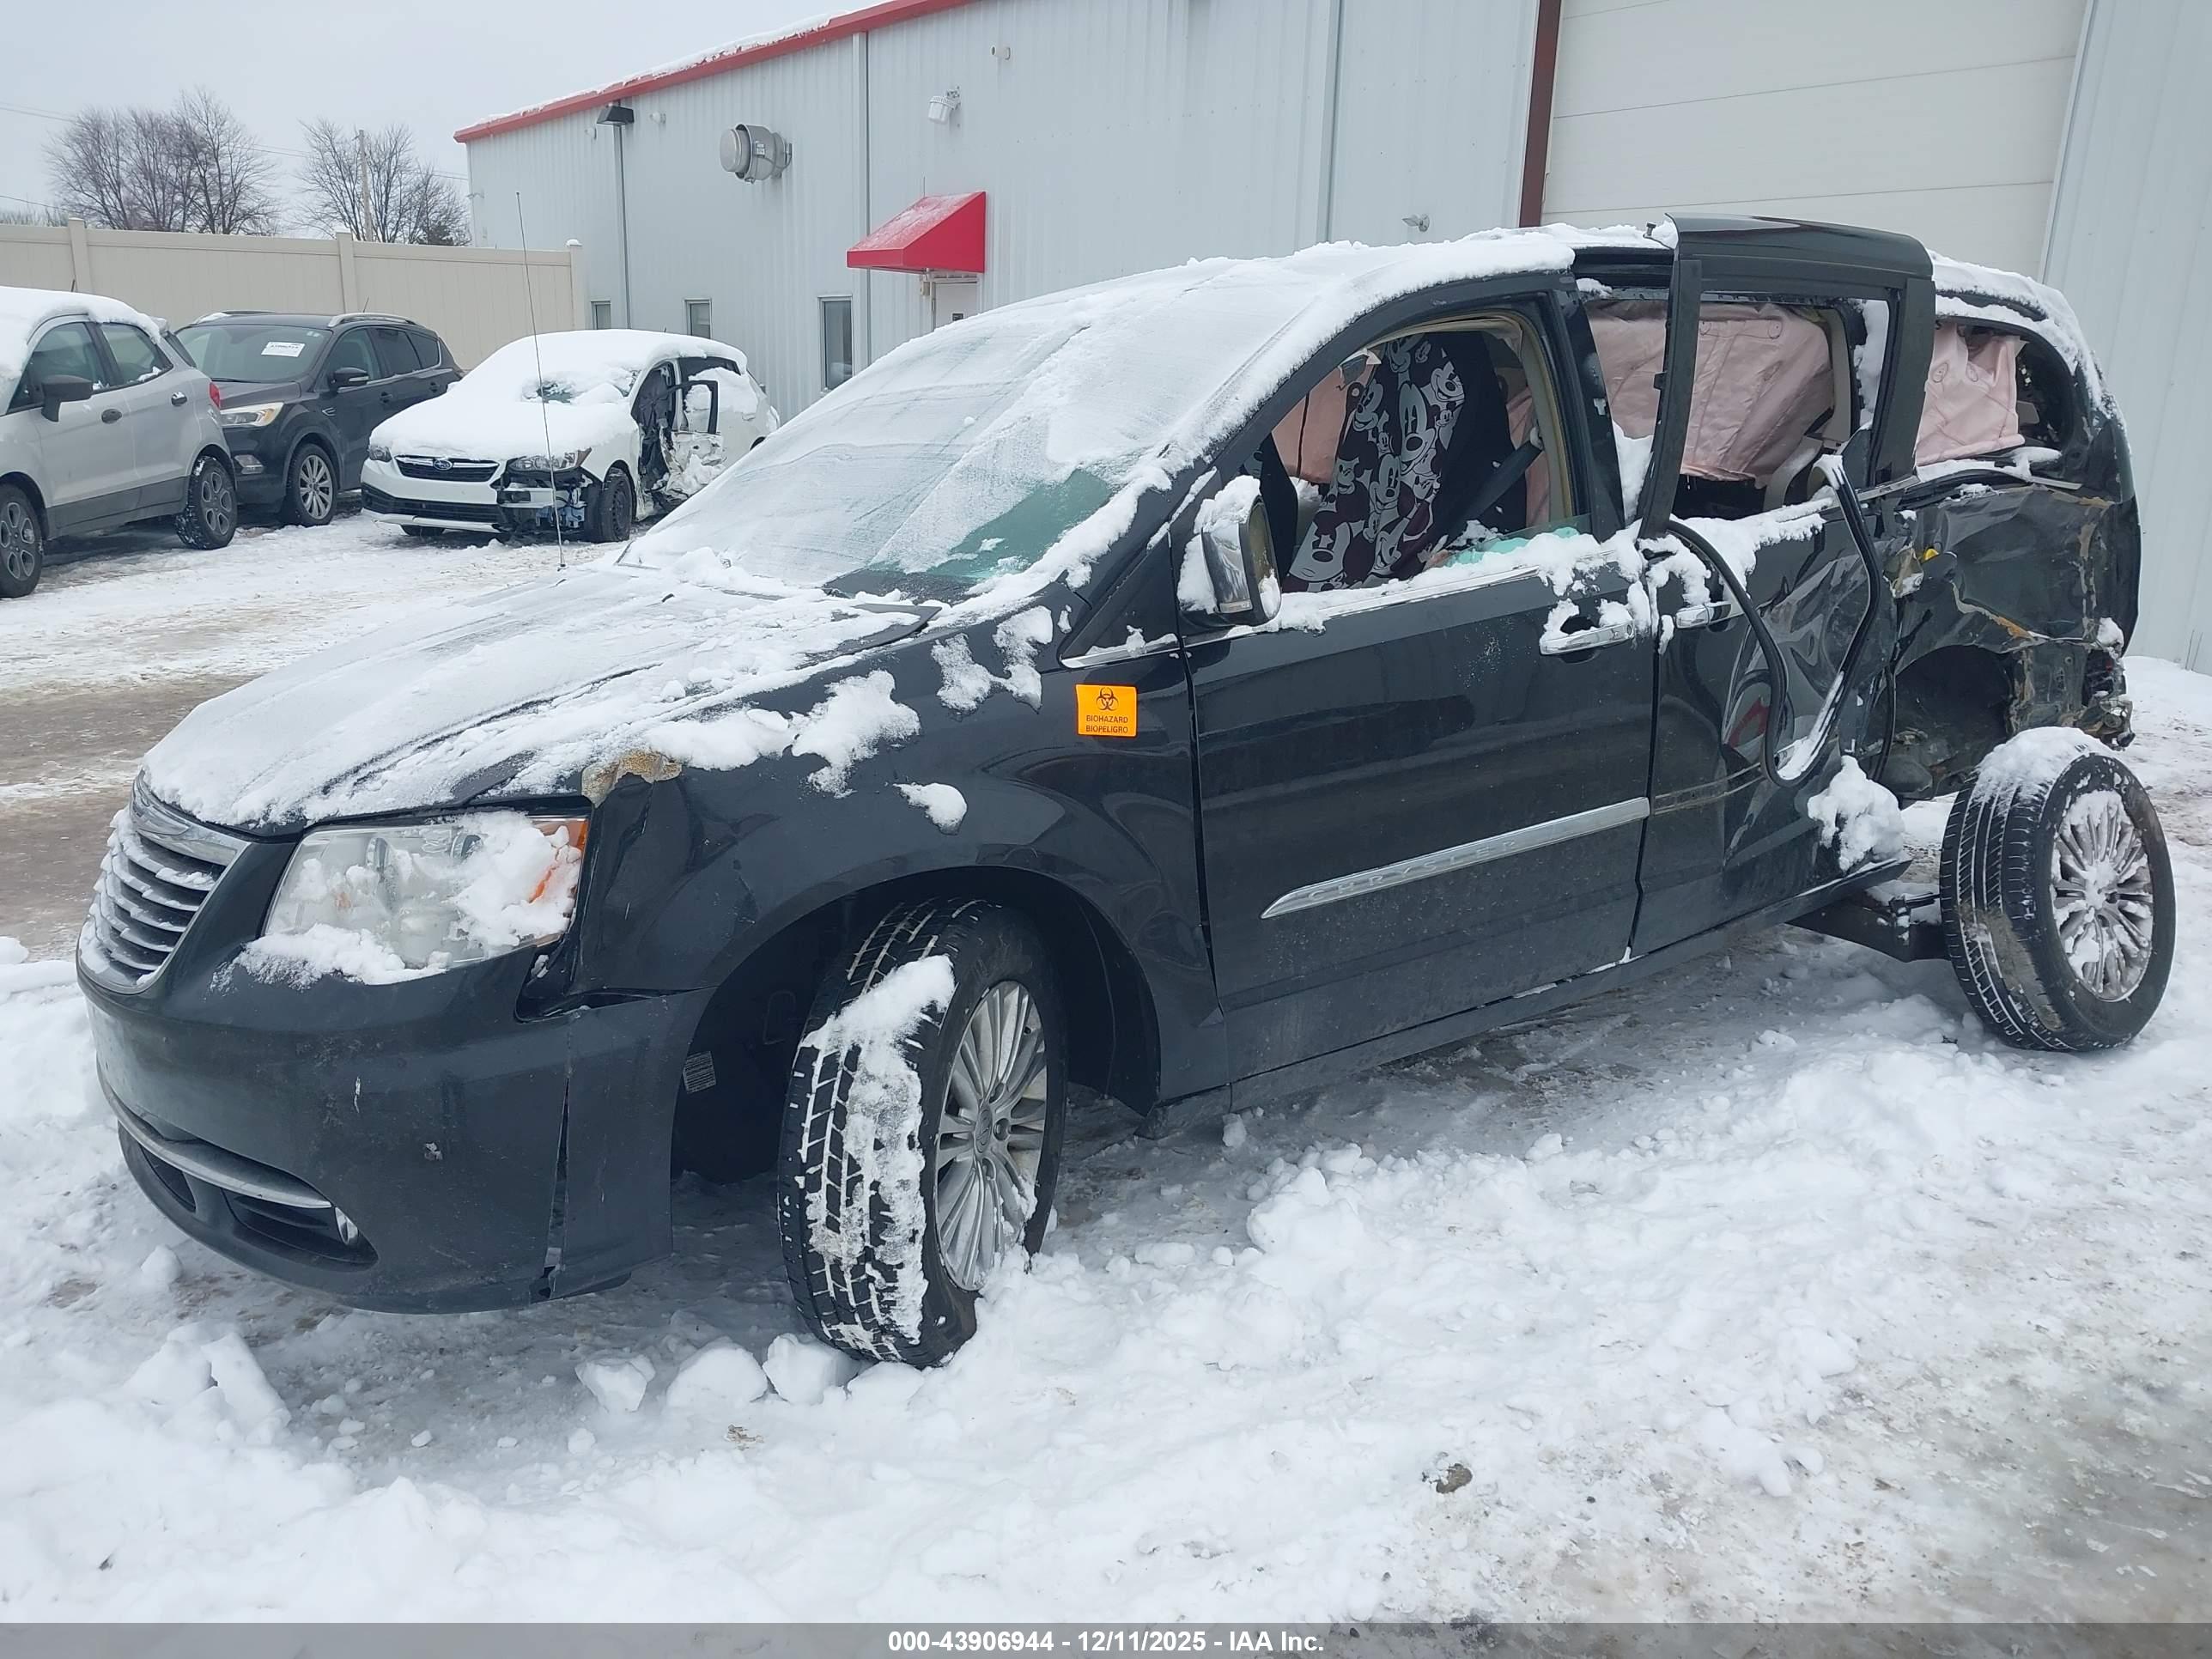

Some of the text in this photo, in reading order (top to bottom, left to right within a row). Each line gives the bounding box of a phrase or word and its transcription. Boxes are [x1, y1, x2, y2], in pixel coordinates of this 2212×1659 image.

[1086, 714, 1128, 724] BIOHAZARD
[1085, 725, 1128, 734] BIOPELIGRO
[1307, 839, 1516, 900] CHRYSLER
